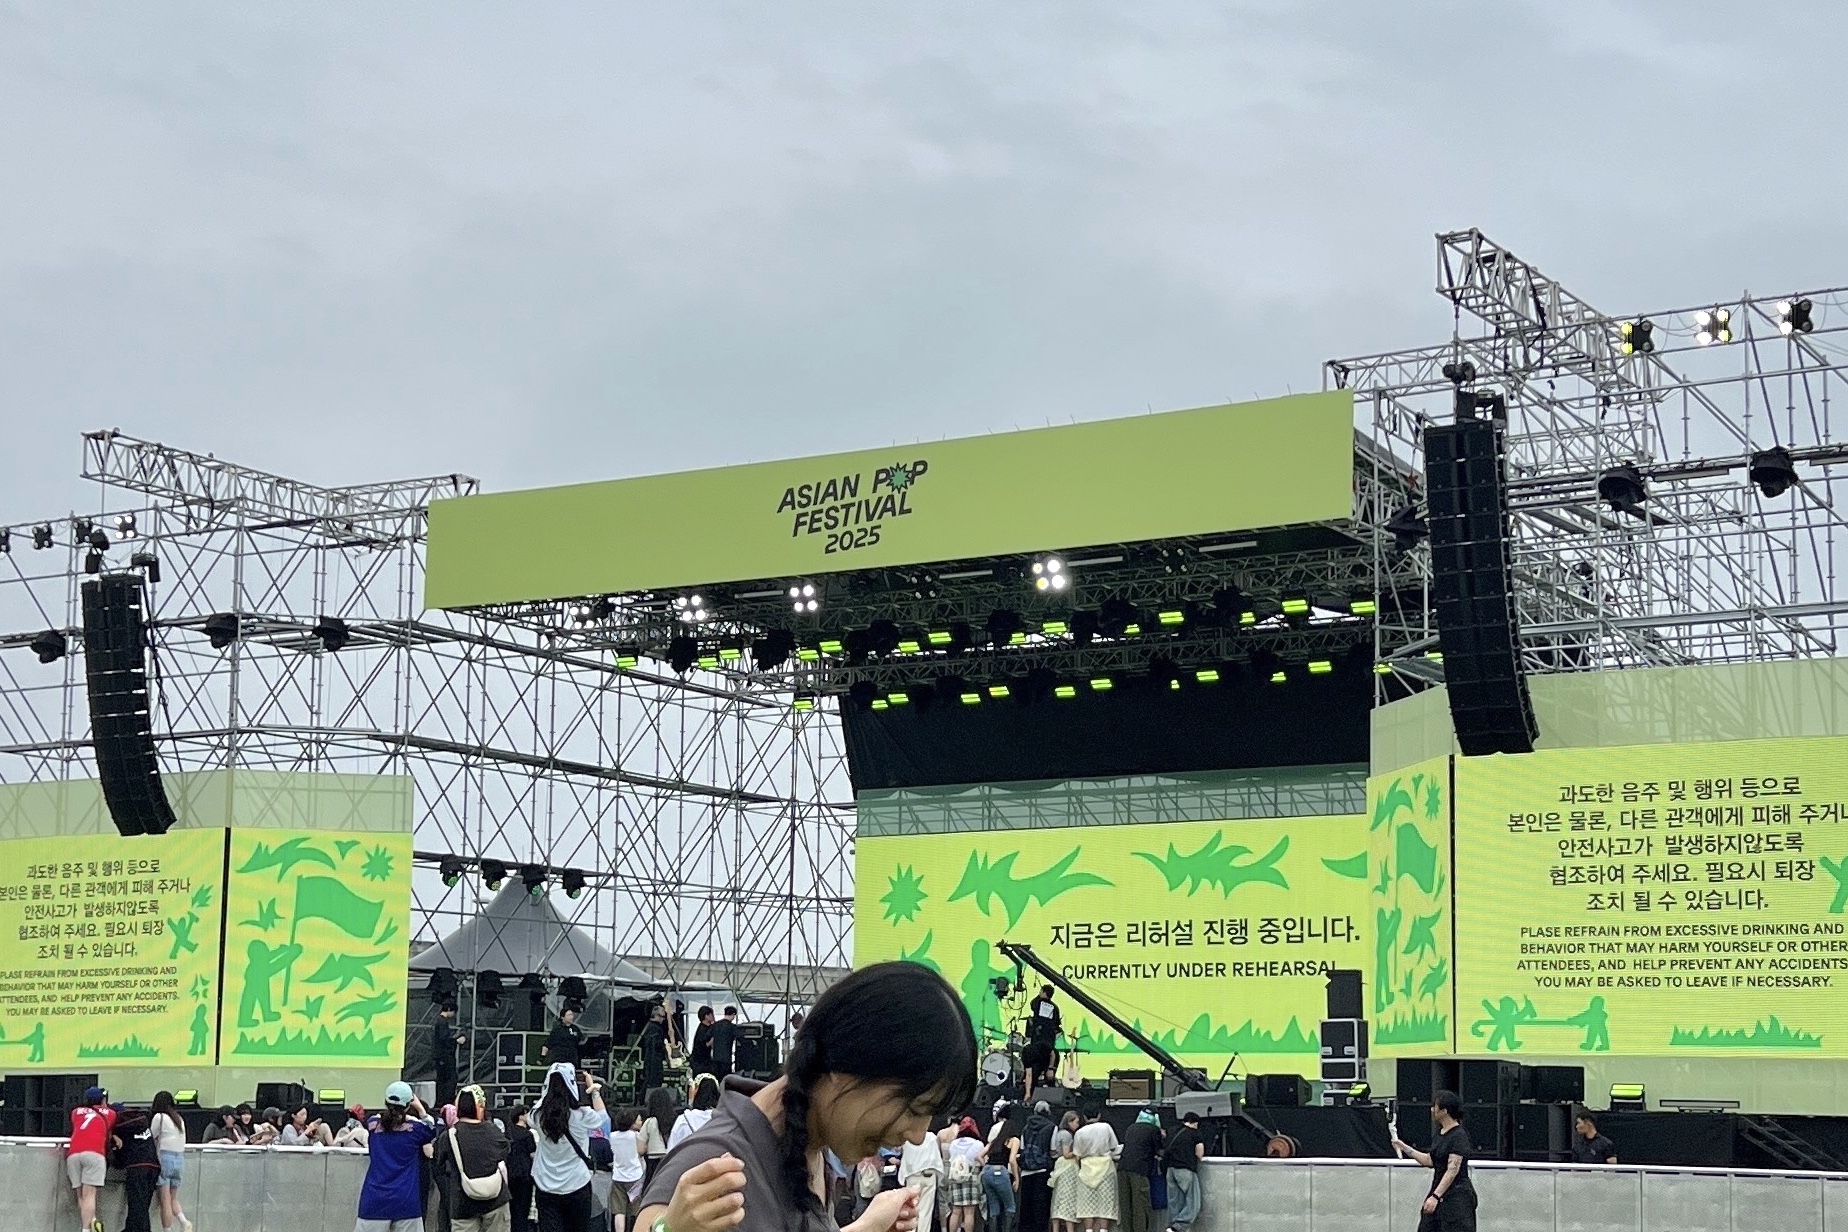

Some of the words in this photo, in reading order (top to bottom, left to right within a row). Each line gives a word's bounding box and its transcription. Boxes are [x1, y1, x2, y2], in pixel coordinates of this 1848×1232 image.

[777, 474, 860, 513] ASIAN
[872, 460, 928, 494] PP
[792, 492, 912, 537] FESTIVAL
[825, 525, 881, 554] 2025
[1559, 783, 1614, 804] 과도한
[1621, 782, 1661, 802] 음주
[1668, 781, 1686, 801] 및
[1694, 778, 1732, 800] 행위
[1740, 776, 1802, 798] 등으로
[1507, 813, 1562, 832] 본인은
[1568, 811, 1611, 831] 물론,
[1620, 809, 1658, 830] 다른
[1665, 806, 1743, 828] 관객에게
[1752, 804, 1790, 825] 피해
[1558, 836, 1653, 858] 안전사고가
[1665, 832, 1804, 855] 발생하지않도록
[27, 864, 58, 879] 과도한
[62, 863, 83, 878] 음주
[88, 862, 98, 877] 및
[102, 860, 123, 876] 행위
[127, 860, 160, 875] 등으로
[1549, 864, 1624, 886] 협조하여
[1632, 863, 1697, 884] 주세요.
[1706, 860, 1765, 882] 필요시
[1774, 860, 1815, 881] 퇴장
[0, 886, 28, 901] 본인은
[32, 885, 55, 900] 물론,
[60, 883, 81, 898] 다른
[85, 880, 128, 897] 관객에게
[132, 879, 153, 894] 피해
[158, 877, 190, 894] 주거나
[1586, 891, 1624, 911] 조치
[1633, 891, 1651, 911] 될
[1658, 891, 1677, 911] 수
[1685, 889, 1768, 910] 있습니다.
[25, 903, 77, 920] 안전사고가
[19, 924, 60, 940] 협조하여
[64, 923, 100, 939] 주세요.
[105, 922, 137, 937] 필요시
[141, 920, 164, 935] 퇴장
[1050, 923, 1117, 949] 지금은
[1127, 919, 1193, 947] 리허설
[1203, 918, 1248, 945] 진행
[1257, 916, 1360, 944] 중입니다.
[1521, 927, 1561, 937] PLASE
[1565, 925, 1620, 937] REFRAIN
[1624, 924, 1661, 937] FROM
[1666, 924, 1738, 937] EXCESSIVE
[1742, 924, 1809, 936] DRINKING
[1813, 922, 1844, 934] AND
[37, 944, 59, 959] 조치
[63, 944, 74, 959] 될
[77, 944, 88, 958] 수
[92, 941, 137, 958] 있습니다.
[1521, 943, 1585, 954] BEHAVIOR
[1589, 942, 1622, 953] THAT
[1626, 942, 1655, 953] MAY
[1659, 942, 1699, 953] HARM
[1703, 940, 1773, 953] YOURSELF
[1777, 941, 1797, 952] OR
[1801, 940, 1848, 952] OTHER
[1061, 963, 1161, 981] CURRENTLY
[1167, 963, 1226, 978] UNDER
[1517, 960, 1594, 972] ATTENDEES,
[1598, 959, 1626, 970] AND
[1633, 959, 1666, 970] HELP
[1670, 959, 1732, 970] PREVENT
[1735, 958, 1764, 969] ANY
[1534, 976, 1561, 988] YOU
[1565, 977, 1593, 987] MAY
[1598, 977, 1613, 987] BE
[1617, 976, 1661, 987] ASKED
[1665, 977, 1682, 987] TO
[1686, 976, 1727, 987] LEAVE
[1732, 976, 1743, 987] IF
[1747, 976, 1833, 987] NECESSARY.
[80, 1113, 97, 1130] 7
